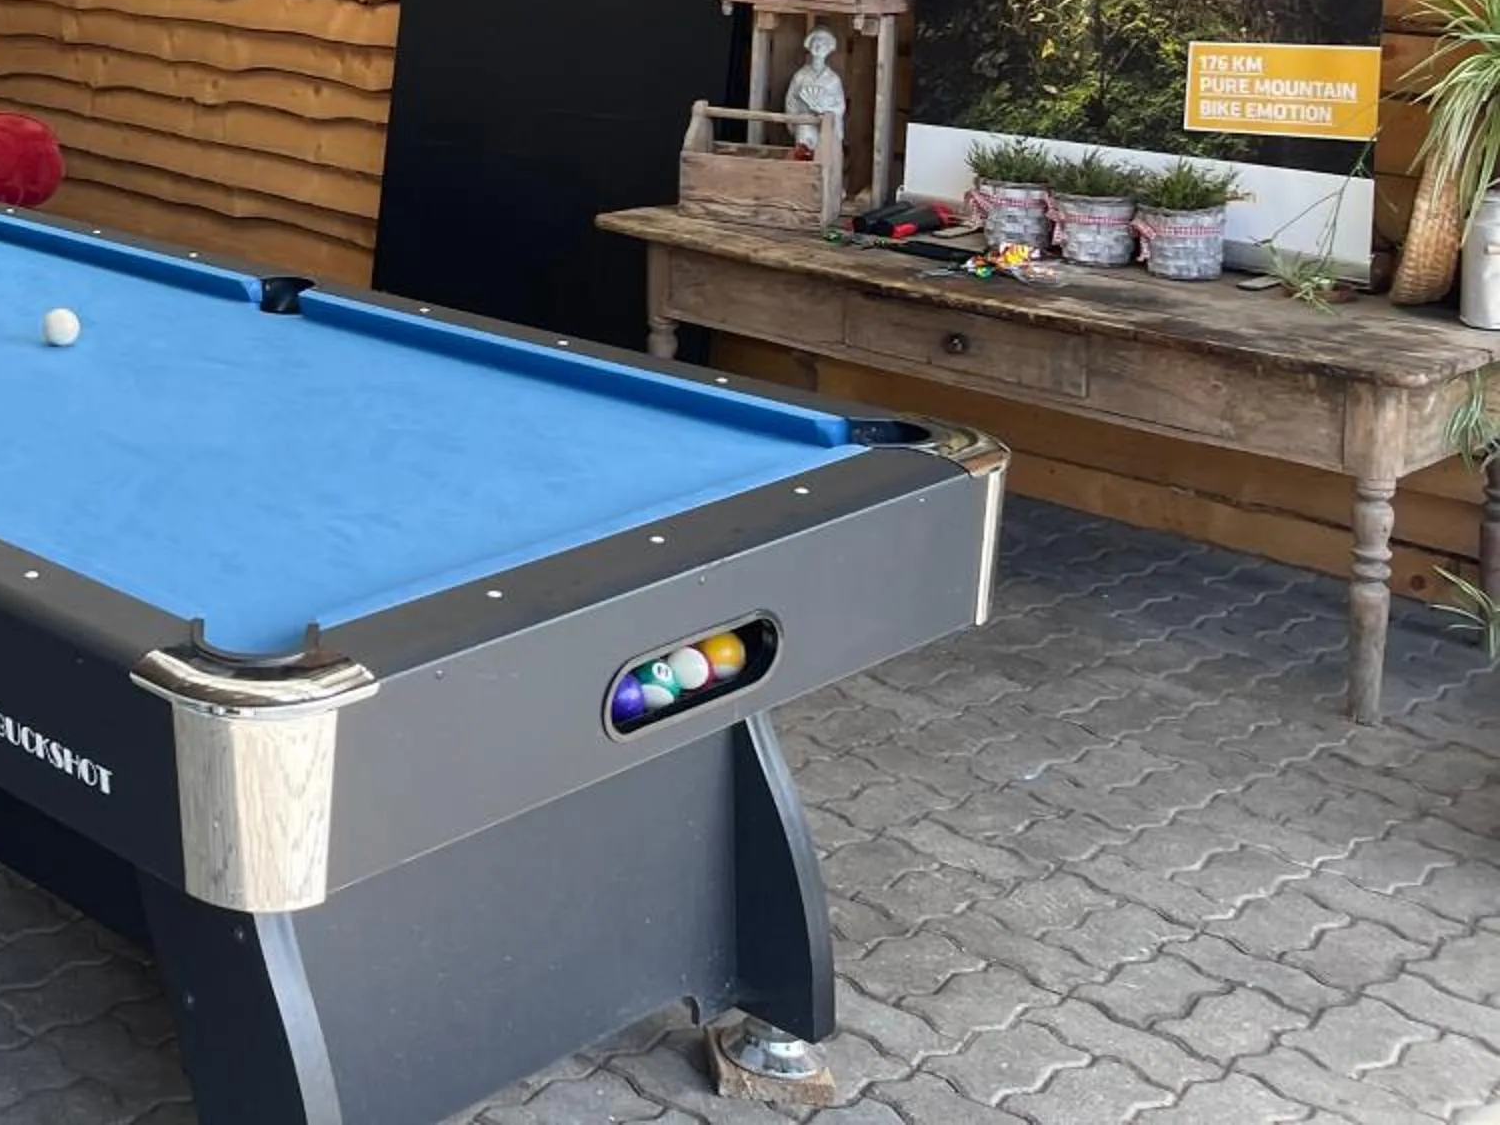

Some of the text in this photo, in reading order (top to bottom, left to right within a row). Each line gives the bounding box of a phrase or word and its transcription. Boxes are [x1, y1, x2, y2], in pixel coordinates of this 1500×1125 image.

[1198, 55, 1263, 72] 176 KM
[1199, 77, 1357, 100] PURE MOUNTAIN
[1200, 99, 1332, 121] BIKE EMOTION
